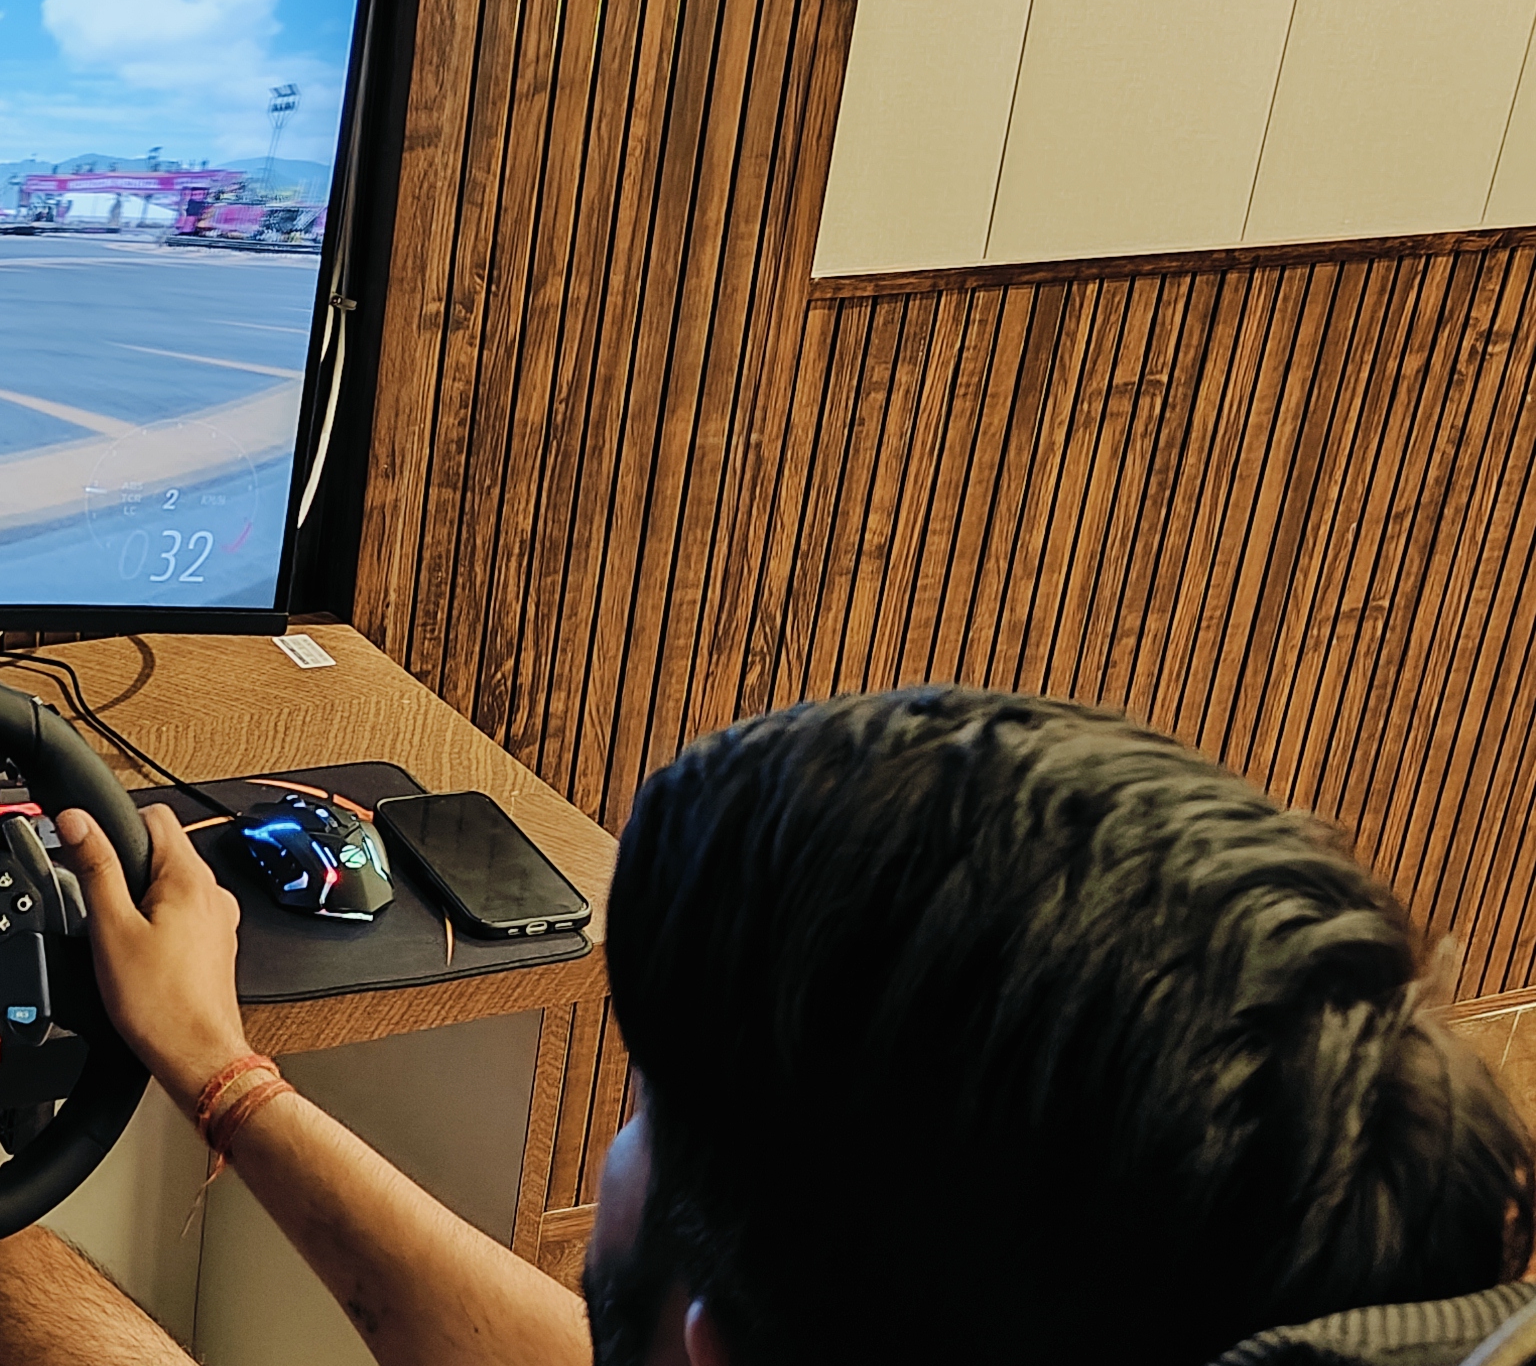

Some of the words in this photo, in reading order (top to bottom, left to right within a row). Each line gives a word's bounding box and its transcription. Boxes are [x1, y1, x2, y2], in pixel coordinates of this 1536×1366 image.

[121, 481, 143, 491] ABS
[162, 489, 179, 510] 2
[123, 506, 137, 516] LC
